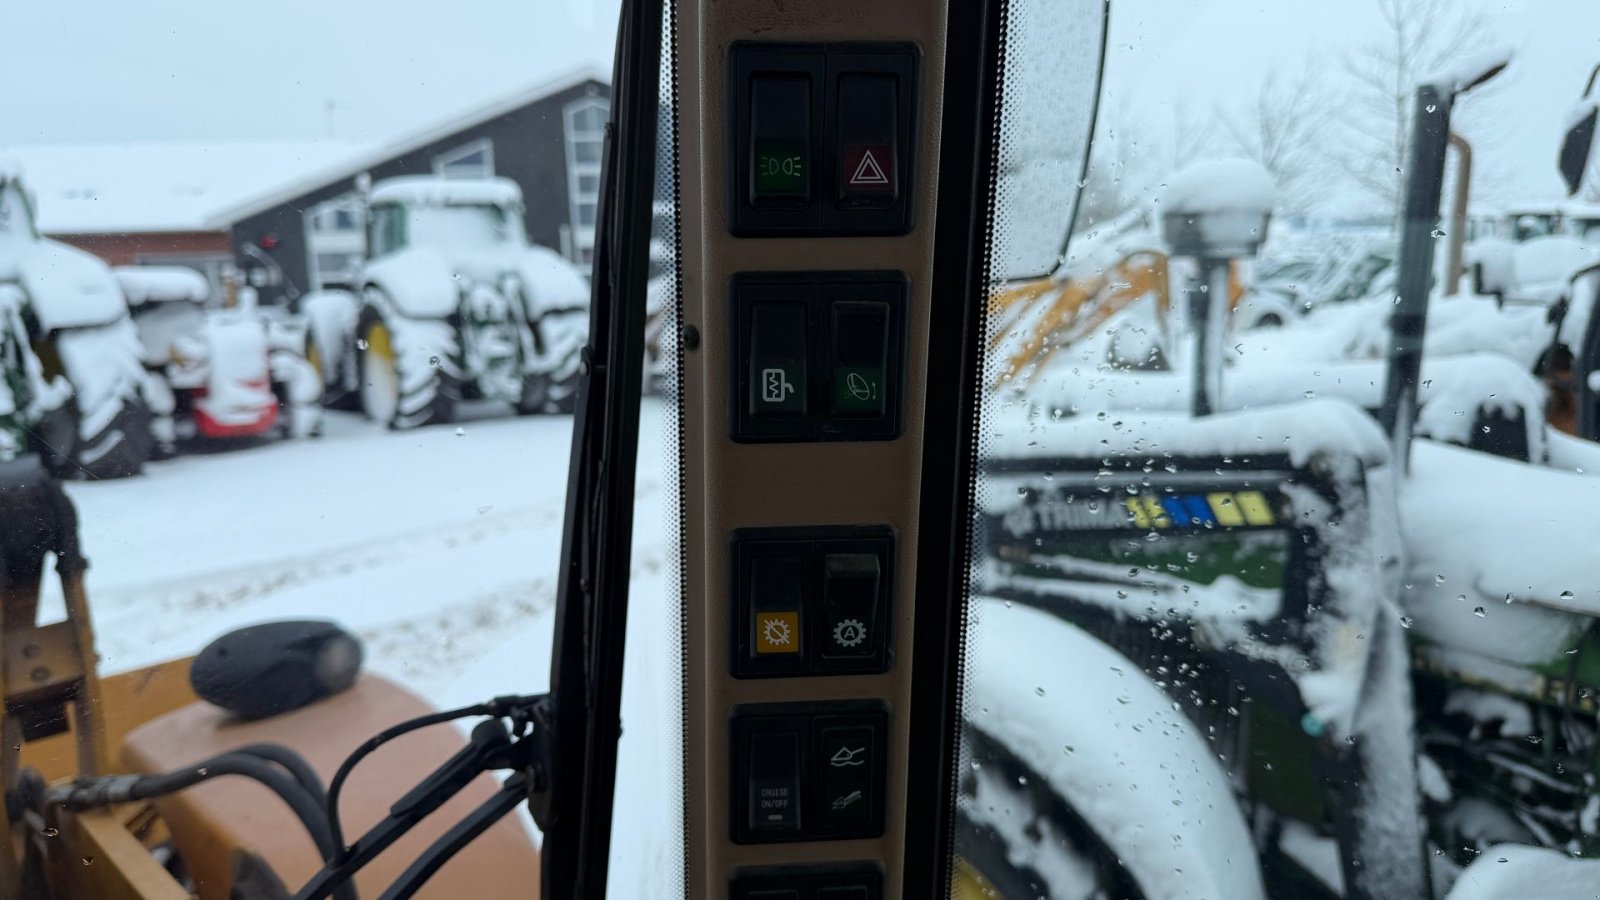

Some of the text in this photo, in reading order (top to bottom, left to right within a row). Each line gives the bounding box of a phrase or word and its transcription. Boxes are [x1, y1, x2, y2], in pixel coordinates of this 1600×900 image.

[844, 626, 856, 639] A
[761, 787, 789, 797] CRUISE
[761, 800, 789, 809] ON/OFF
